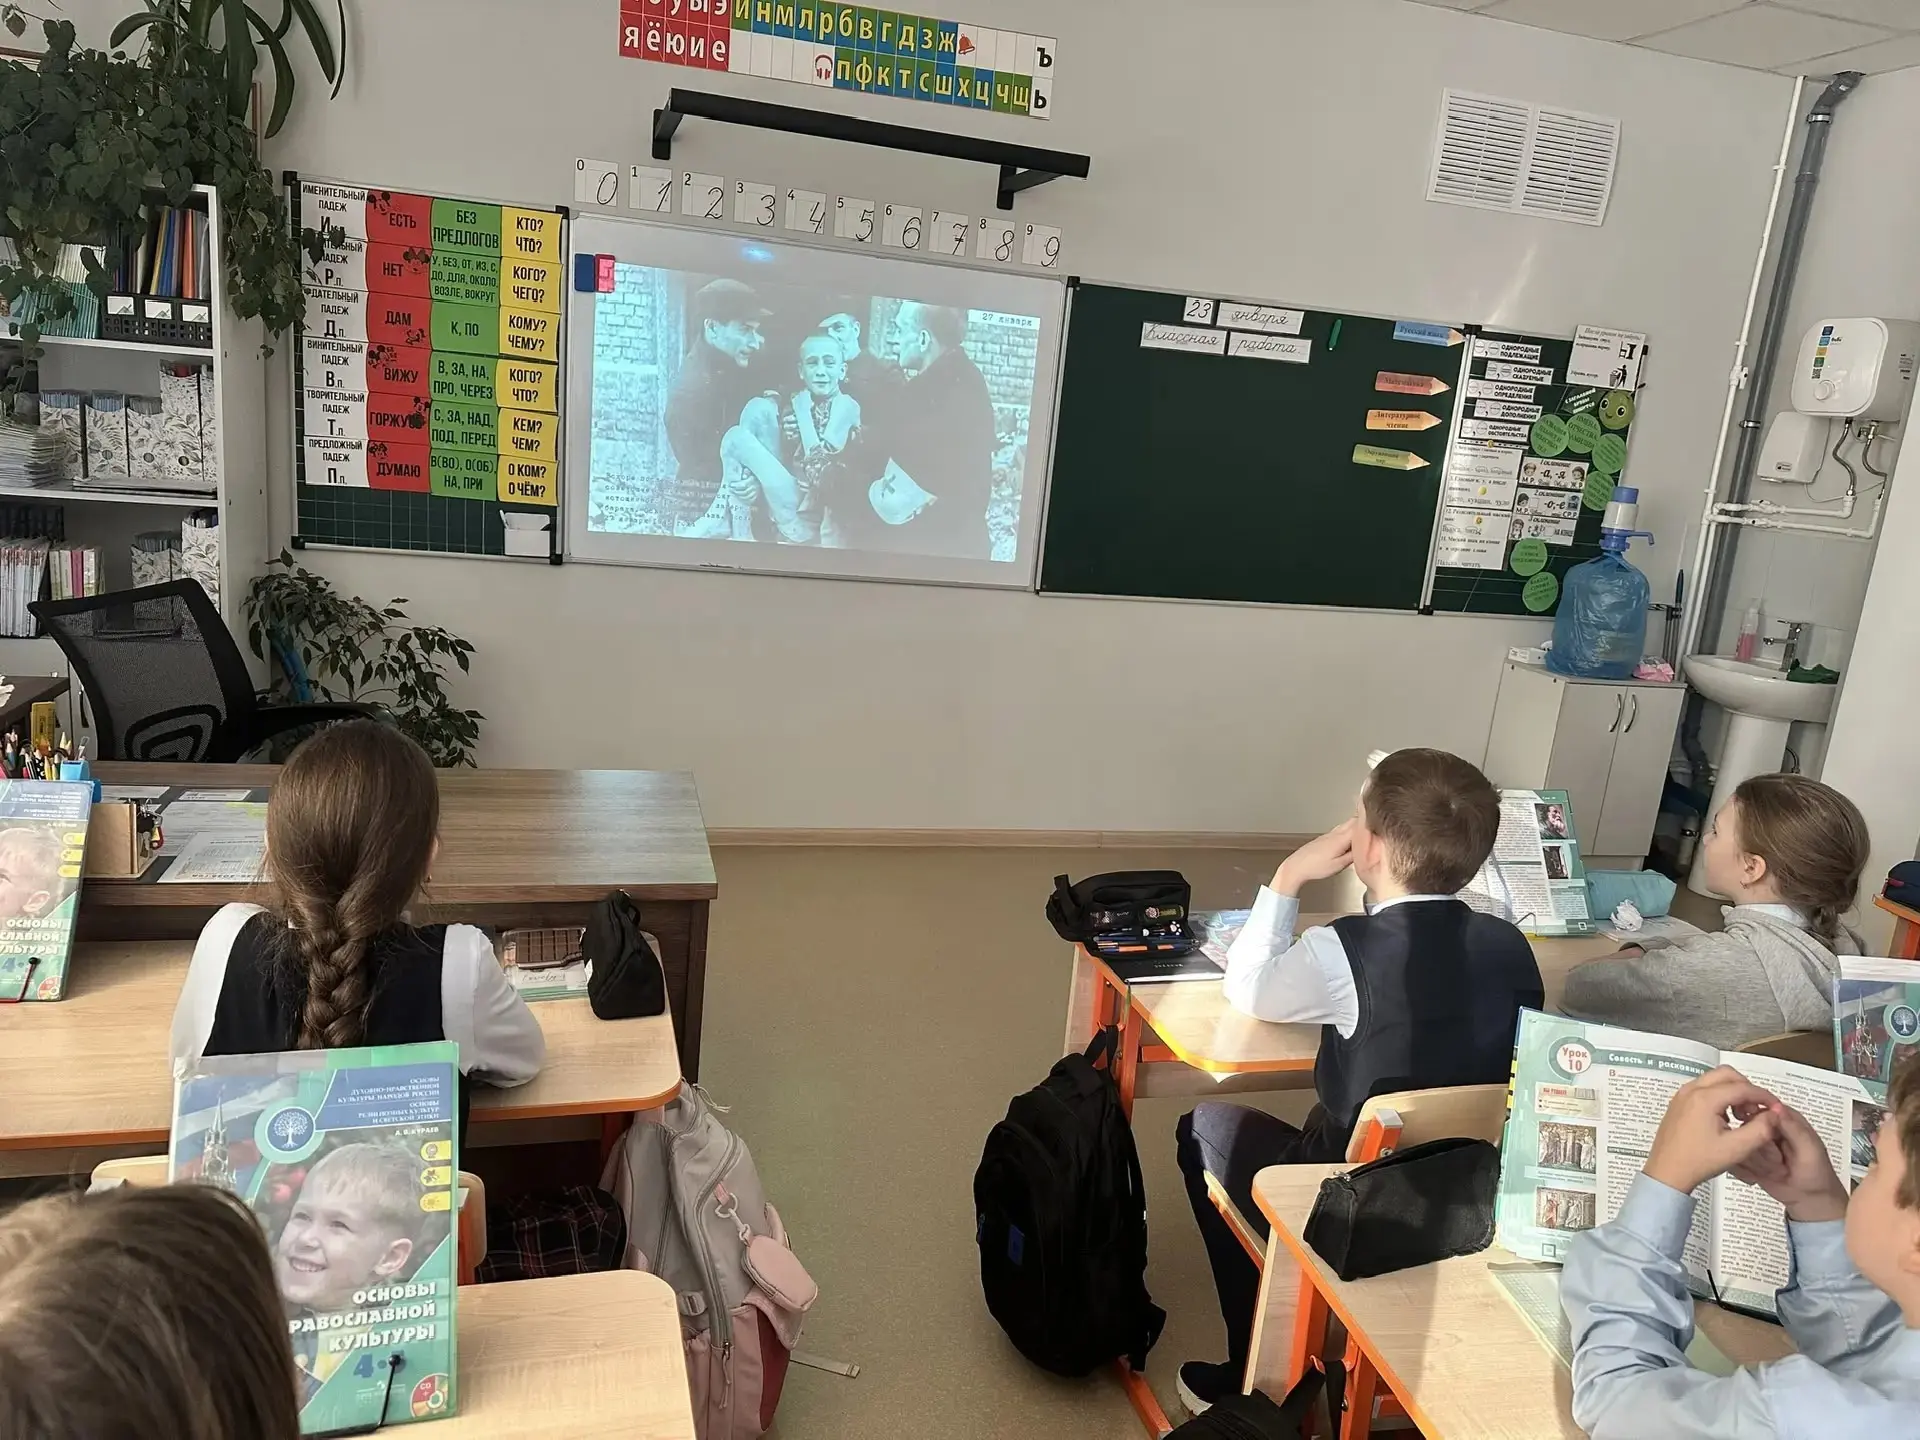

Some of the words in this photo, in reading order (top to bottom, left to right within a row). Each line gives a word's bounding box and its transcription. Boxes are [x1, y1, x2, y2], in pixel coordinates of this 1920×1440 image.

[576, 159, 585, 171] 0
[631, 166, 638, 178] 1
[684, 172, 692, 186] 2
[302, 183, 366, 201] ИМЕНИТЕЛЬНЫЙ
[597, 171, 618, 205] 0
[658, 181, 673, 212] 1
[737, 182, 744, 194] 3
[787, 189, 795, 201] 4
[318, 199, 347, 213] ПАДЕЖ
[704, 186, 724, 220] 2
[756, 194, 776, 226] 3
[837, 197, 844, 209] 5
[885, 204, 893, 216] 6
[389, 212, 417, 229] ЕСТЬ
[456, 209, 477, 225] БЕЗ
[516, 216, 544, 233] КТО?
[809, 202, 826, 234] 4
[855, 209, 875, 242] 5
[932, 211, 939, 223] 7
[979, 218, 987, 230] 8
[433, 227, 499, 249] ПРЕДЛОГОВ
[901, 216, 922, 249] 6
[1026, 224, 1034, 236] 9
[515, 236, 543, 254] ЧТО?
[952, 223, 969, 256] 7
[995, 230, 1015, 262] 8
[1040, 236, 1061, 267] 9
[383, 261, 404, 277] НЕТ
[513, 265, 547, 283] КОГО?
[311, 288, 359, 304] ДАТЕЛЬНЫЙ
[465, 289, 495, 303] ВОКРУГ
[512, 285, 545, 303] ЧЕГО?
[321, 304, 349, 316] ПАДЕЖ
[1186, 299, 1212, 319] 23
[385, 310, 412, 327] ДАМ
[508, 314, 547, 333] КОМУ?
[982, 312, 994, 321] 27
[998, 316, 1033, 327] января
[451, 321, 462, 337] К,
[465, 322, 479, 337] ПО
[1145, 322, 1220, 345] Классная
[307, 339, 364, 354] ВИНИТЕЛЬНЫЙ
[507, 334, 545, 352] ЧЕМУ?
[321, 354, 350, 366] ПАДЕЖ
[384, 367, 419, 384] ВИЖУ
[438, 360, 449, 375] В,
[451, 362, 469, 378] ЗА,
[471, 365, 490, 380] НА,
[509, 368, 543, 384] КОГО?
[306, 389, 365, 403] ТВОРИТЕЛЬНЫЙ
[433, 380, 458, 397] ПРО,
[460, 383, 493, 400] ЧЕРЕЗ
[512, 388, 539, 403] ЧТО?
[322, 403, 350, 415] ПАДЕЖ
[434, 408, 444, 424] С,
[447, 410, 465, 426] ЗА,
[467, 412, 494, 429] НАД,
[513, 417, 543, 434] КЕМ?
[309, 439, 363, 450] ПРЕДЛОЖНЫЙ
[431, 428, 459, 445] ПОД,
[461, 431, 496, 448] ПЕРЕД
[512, 436, 541, 453] ЧЕМ?
[322, 452, 350, 463] ПАДЕЖ
[376, 461, 421, 478] ДУМАЮ
[508, 463, 515, 476] О
[517, 463, 547, 479] КОМ?
[444, 475, 461, 490] НА,
[463, 476, 483, 491] ПРИ
[508, 482, 516, 495] О
[517, 480, 546, 498] ЧЁМ?
[0, 945, 59, 956] УЛЬТУРЫ
[1562, 1047, 1588, 1060] Урок
[1608, 1053, 1644, 1065] Совесть
[1568, 1059, 1583, 1072] 10
[352, 1281, 437, 1305] ОСНОВЫ
[288, 1299, 436, 1335] РАВОСЛАВНОЙ
[328, 1324, 436, 1354] КУЛЬТУРЫ
